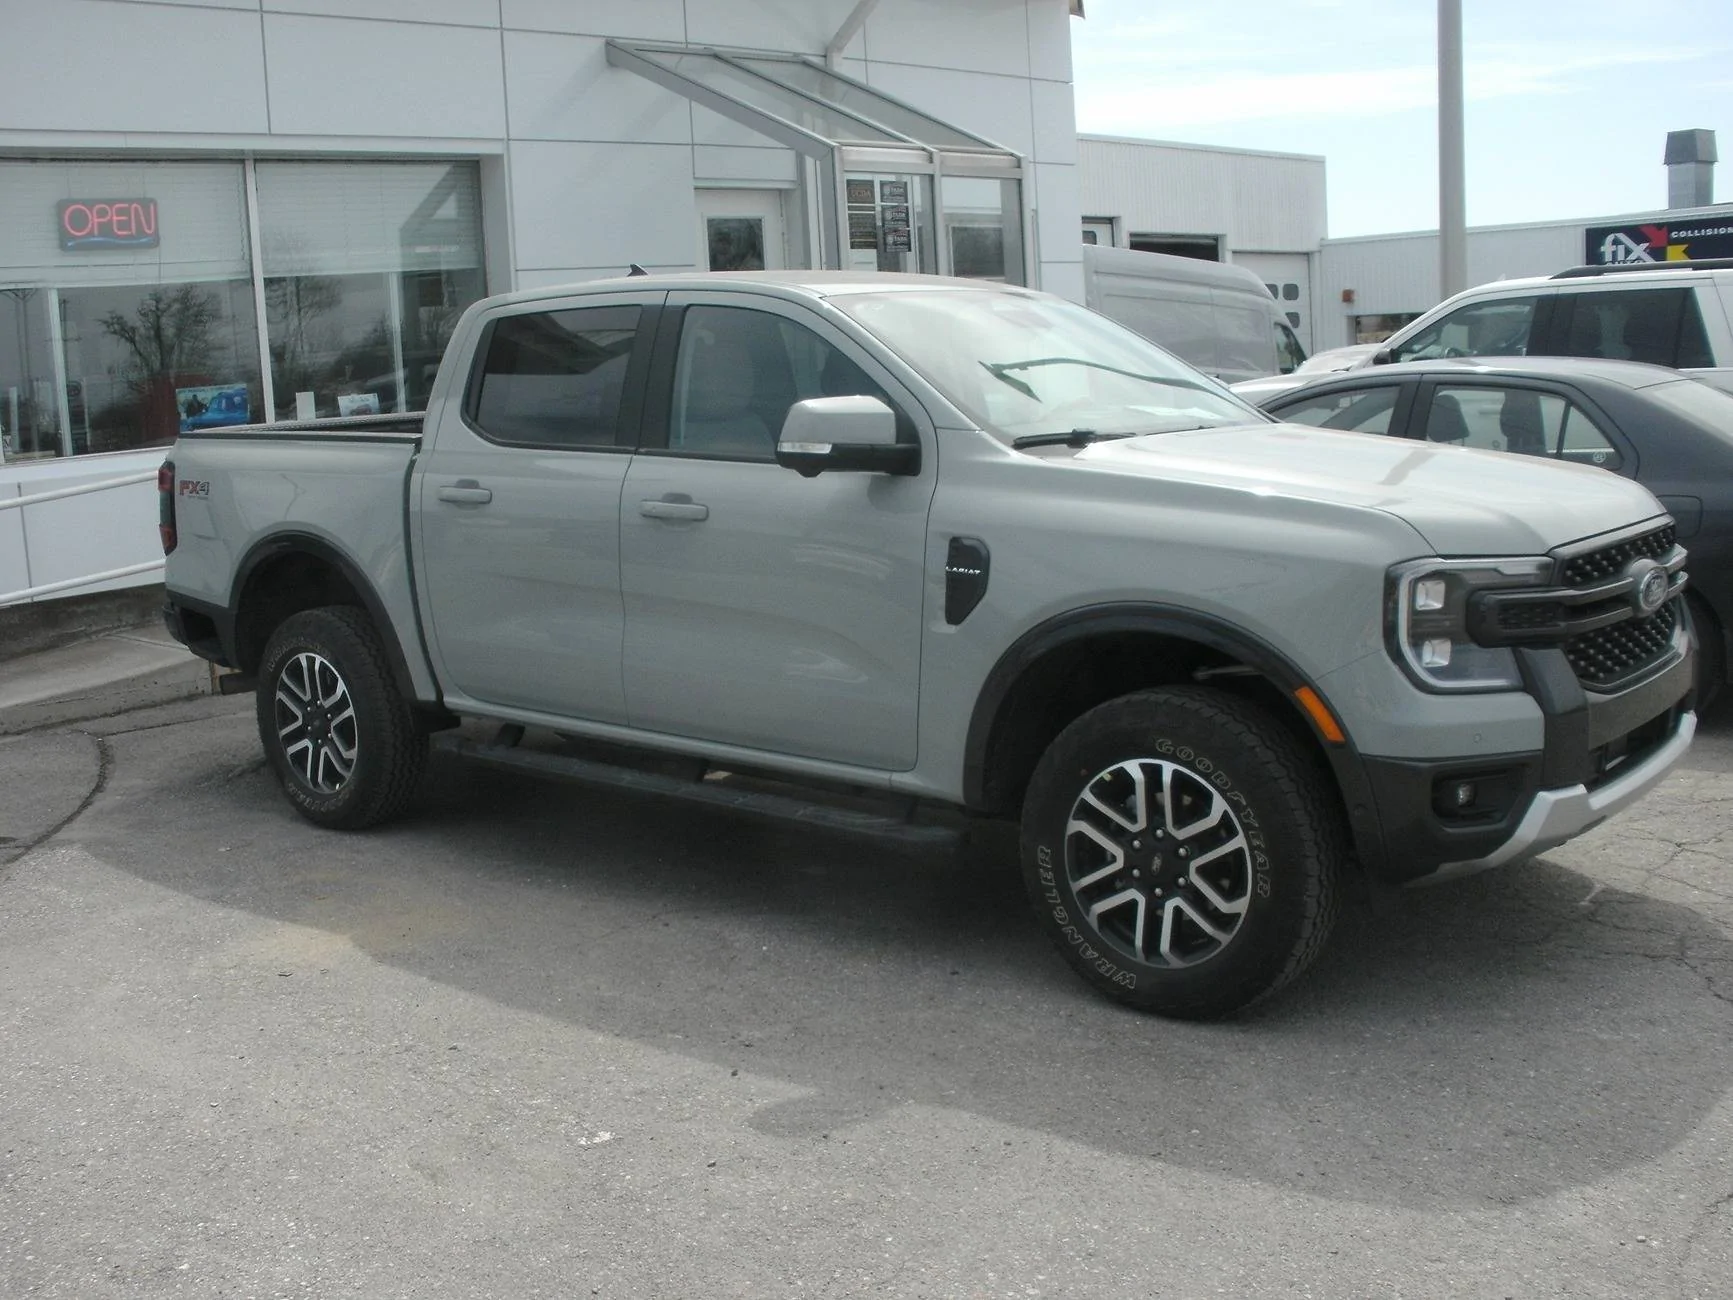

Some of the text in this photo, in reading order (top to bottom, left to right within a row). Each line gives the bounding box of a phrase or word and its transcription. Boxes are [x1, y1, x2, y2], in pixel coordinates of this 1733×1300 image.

[64, 202, 156, 237] OPEN
[179, 479, 211, 496] FX4
[1154, 737, 1271, 898] GOODYEAR
[1036, 845, 1138, 990] WRANGLER
